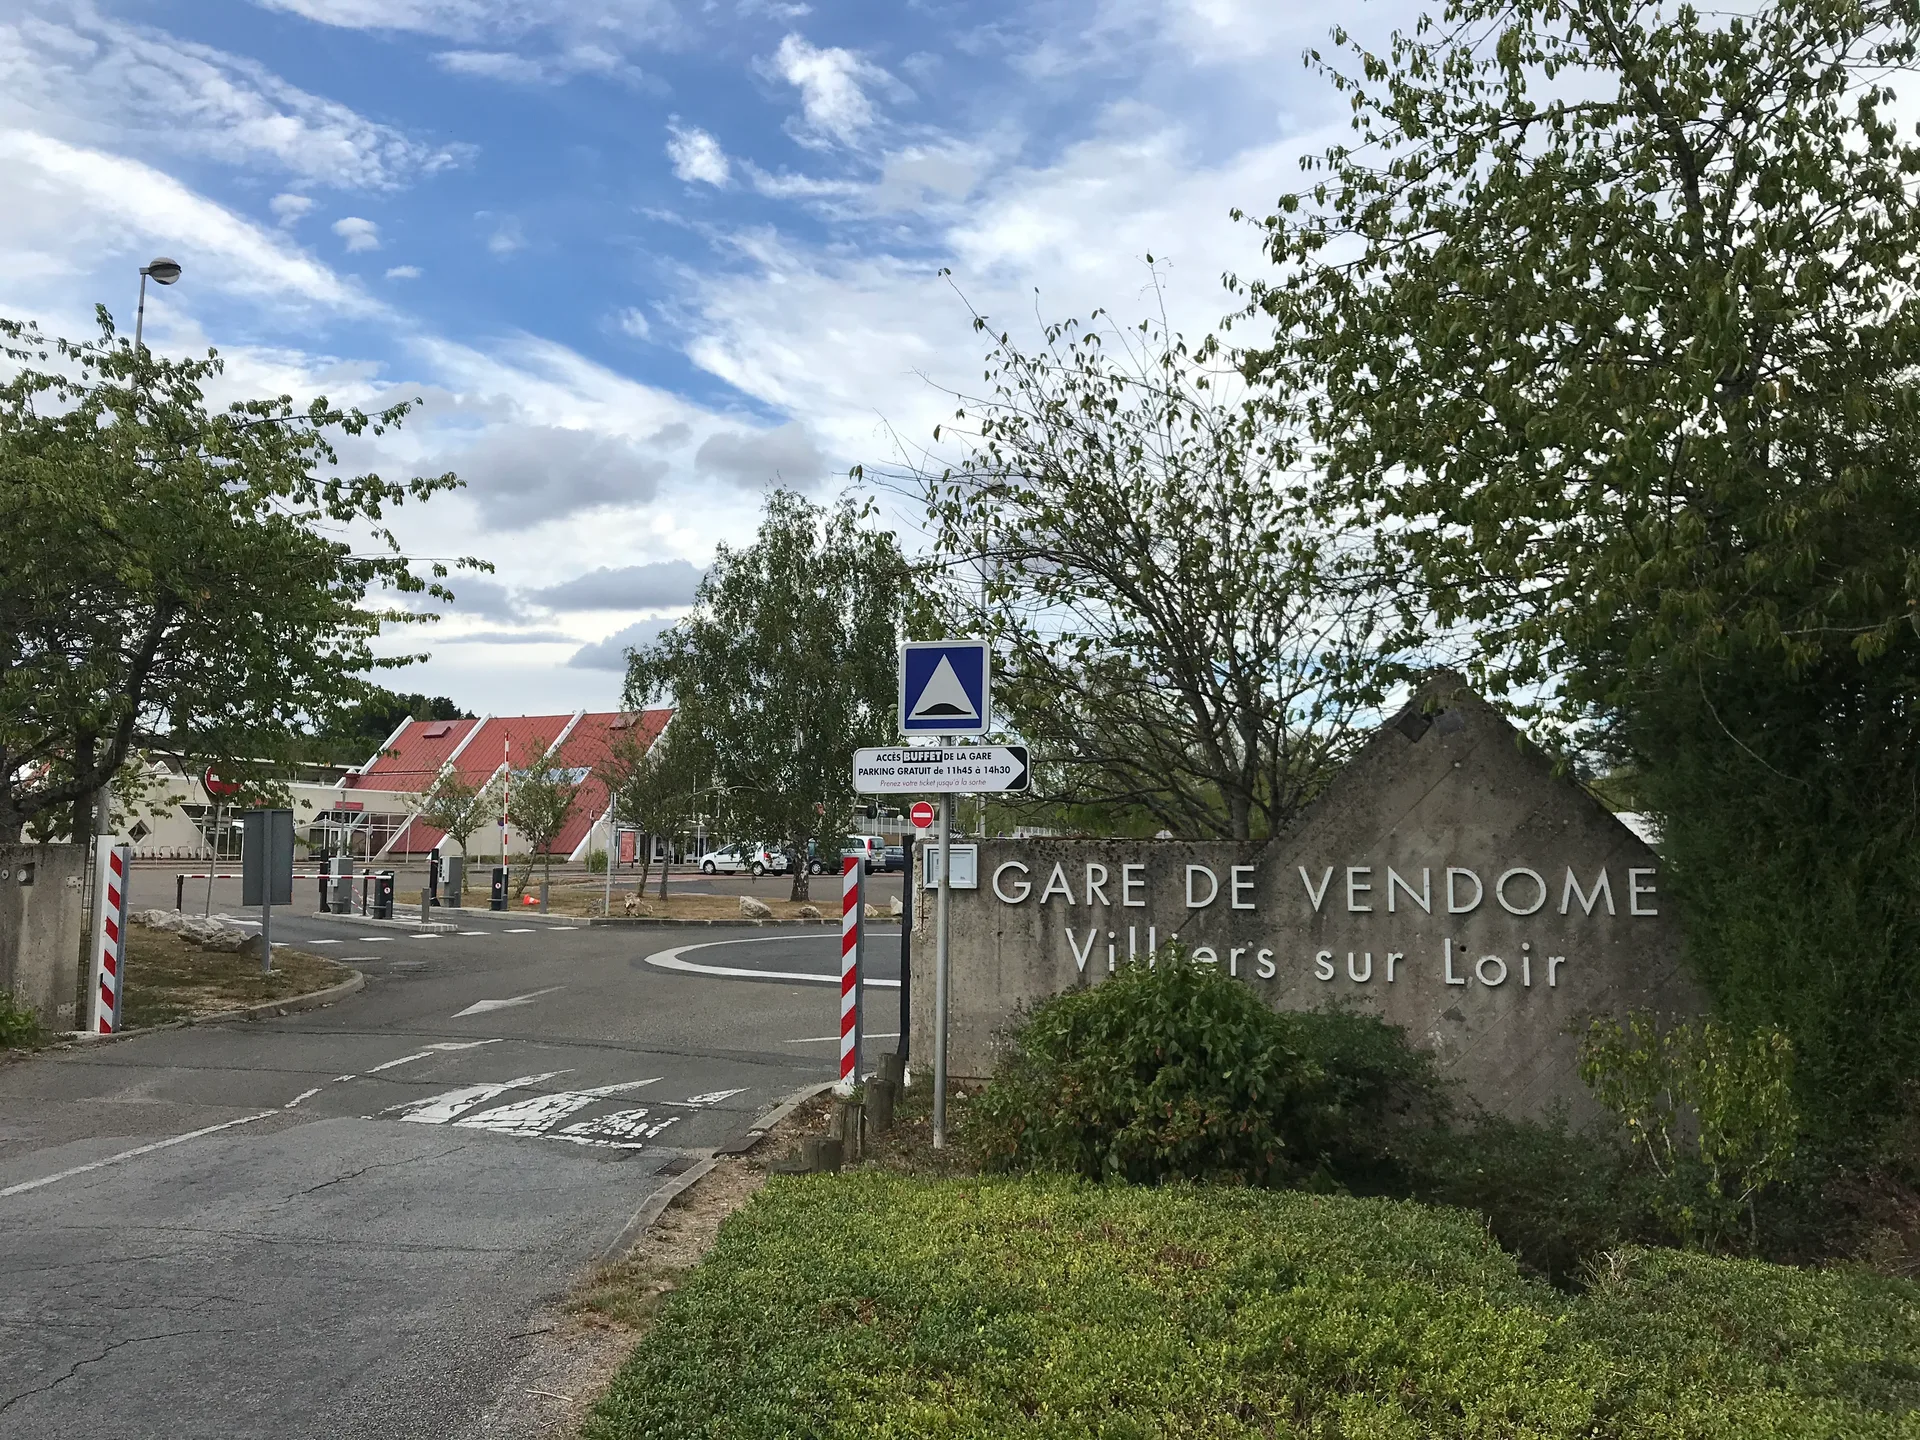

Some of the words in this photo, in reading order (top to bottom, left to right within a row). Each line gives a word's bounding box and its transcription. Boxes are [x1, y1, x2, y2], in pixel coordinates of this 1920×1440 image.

[876, 752, 901, 762] ACCÈS
[903, 751, 942, 762] BUFFET
[944, 752, 954, 761] DE
[956, 752, 966, 760] LA
[969, 752, 992, 760] GARE
[858, 767, 895, 776] PARKING
[897, 767, 931, 775] GRATUIT
[933, 766, 944, 774] de
[946, 766, 973, 774] 11h45
[975, 766, 981, 774] à
[984, 766, 1011, 774] 14h30
[880, 779, 901, 787] Prenez
[919, 778, 936, 787] ticket
[936, 778, 959, 788] jusqu'à
[961, 778, 967, 786] la
[992, 861, 1146, 907] GARE
[1185, 865, 1257, 910] DE
[1297, 866, 1659, 916] VENDOME
[1314, 942, 1403, 982] sur
[1444, 938, 1567, 988] Loir
